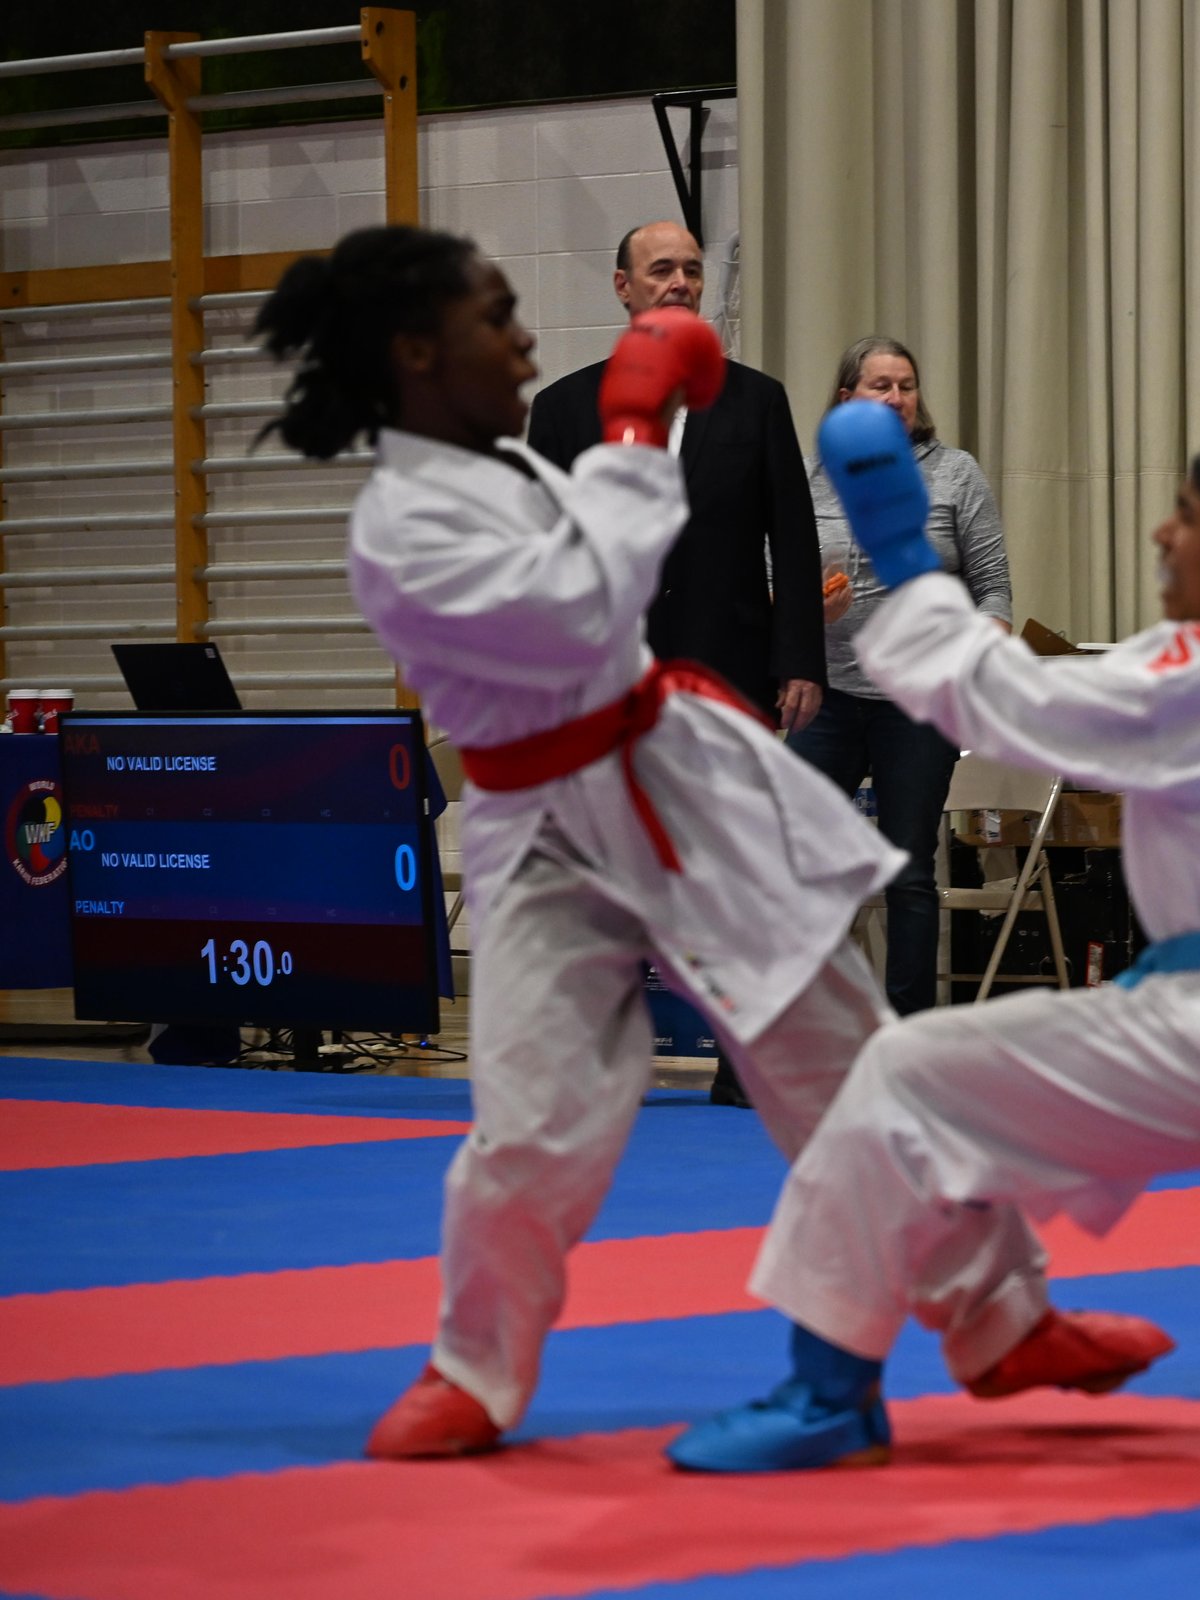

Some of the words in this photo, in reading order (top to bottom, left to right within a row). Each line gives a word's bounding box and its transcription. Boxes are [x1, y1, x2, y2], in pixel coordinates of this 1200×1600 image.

[65, 734, 99, 755] AKA
[106, 756, 125, 771] NO
[126, 756, 162, 771] VALID
[164, 756, 217, 771] LICENSE
[389, 743, 411, 790] 0
[71, 804, 119, 818] PENALTY
[69, 829, 95, 851] AO
[101, 853, 119, 867] NO
[121, 853, 156, 868] VALID
[159, 854, 210, 869] LICENSE
[395, 844, 416, 891] 0
[75, 901, 125, 915] PENALTY
